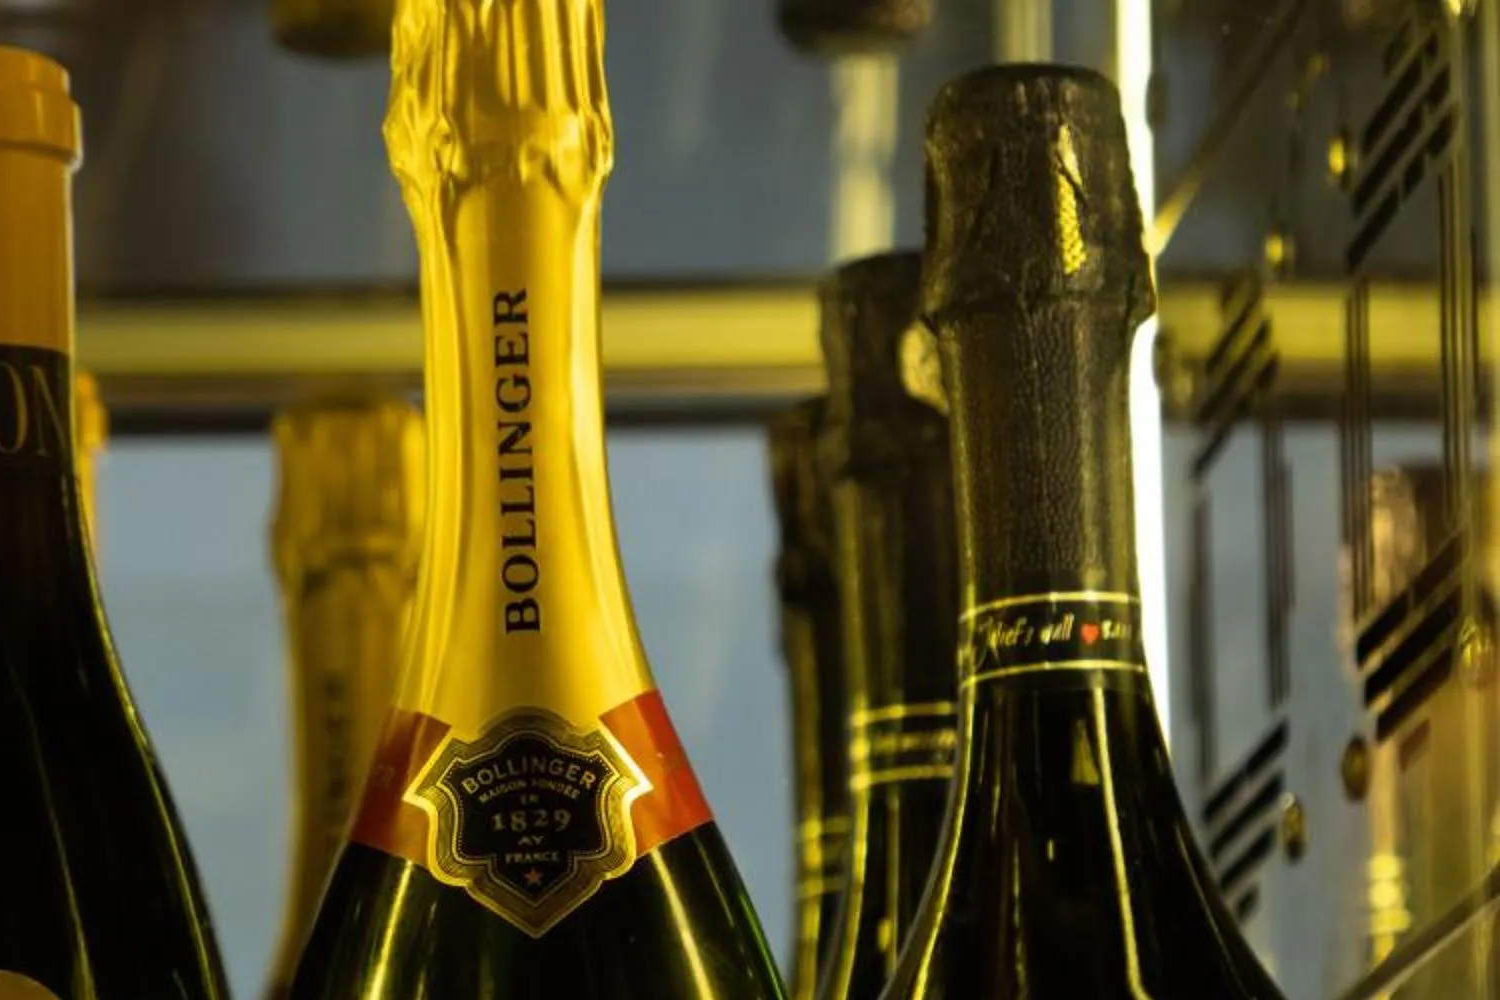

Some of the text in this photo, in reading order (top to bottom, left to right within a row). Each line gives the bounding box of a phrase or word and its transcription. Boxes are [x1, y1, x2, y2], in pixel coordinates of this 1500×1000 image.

[493, 288, 541, 634] BOLLINGER
[460, 755, 597, 796] BOLLINGER
[491, 808, 572, 833] 1829
